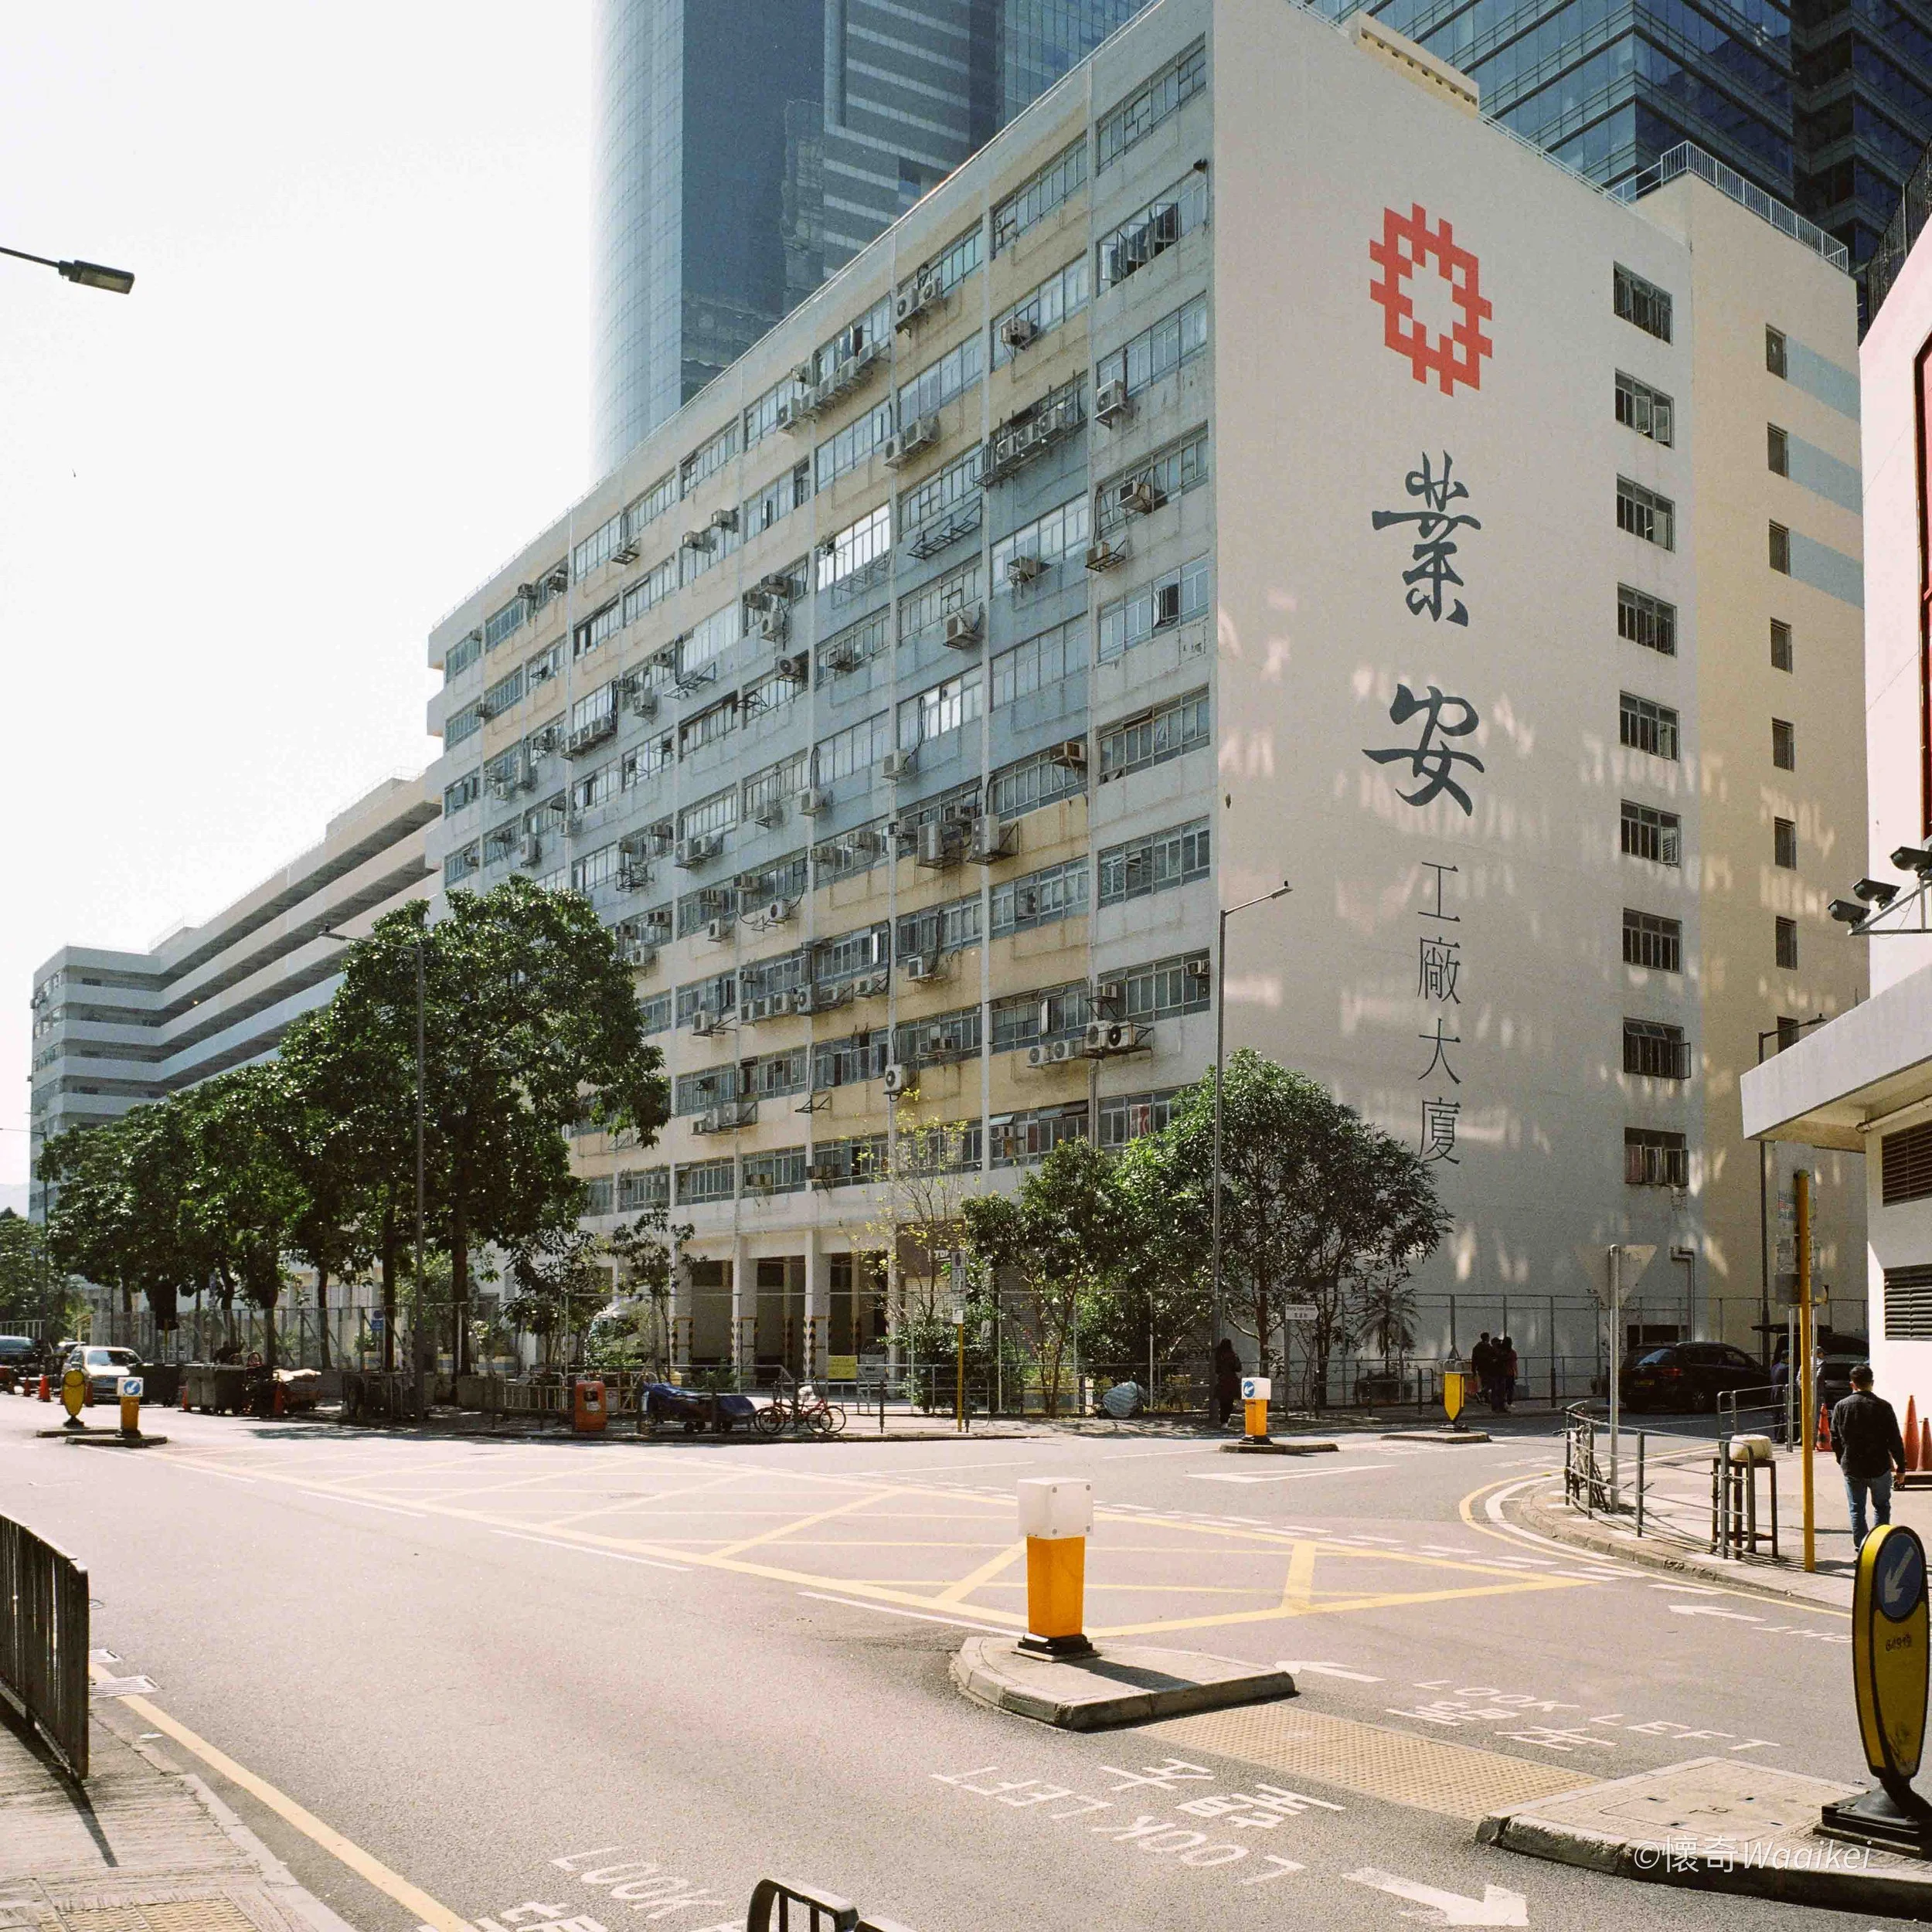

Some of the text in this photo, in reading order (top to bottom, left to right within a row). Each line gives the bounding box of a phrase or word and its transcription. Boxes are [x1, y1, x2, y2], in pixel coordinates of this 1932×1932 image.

[1413, 1680, 1781, 1751] LOOK LEFT
[930, 1767, 1306, 1886] LOOK LEFT
[549, 1845, 729, 1919] LOOK
